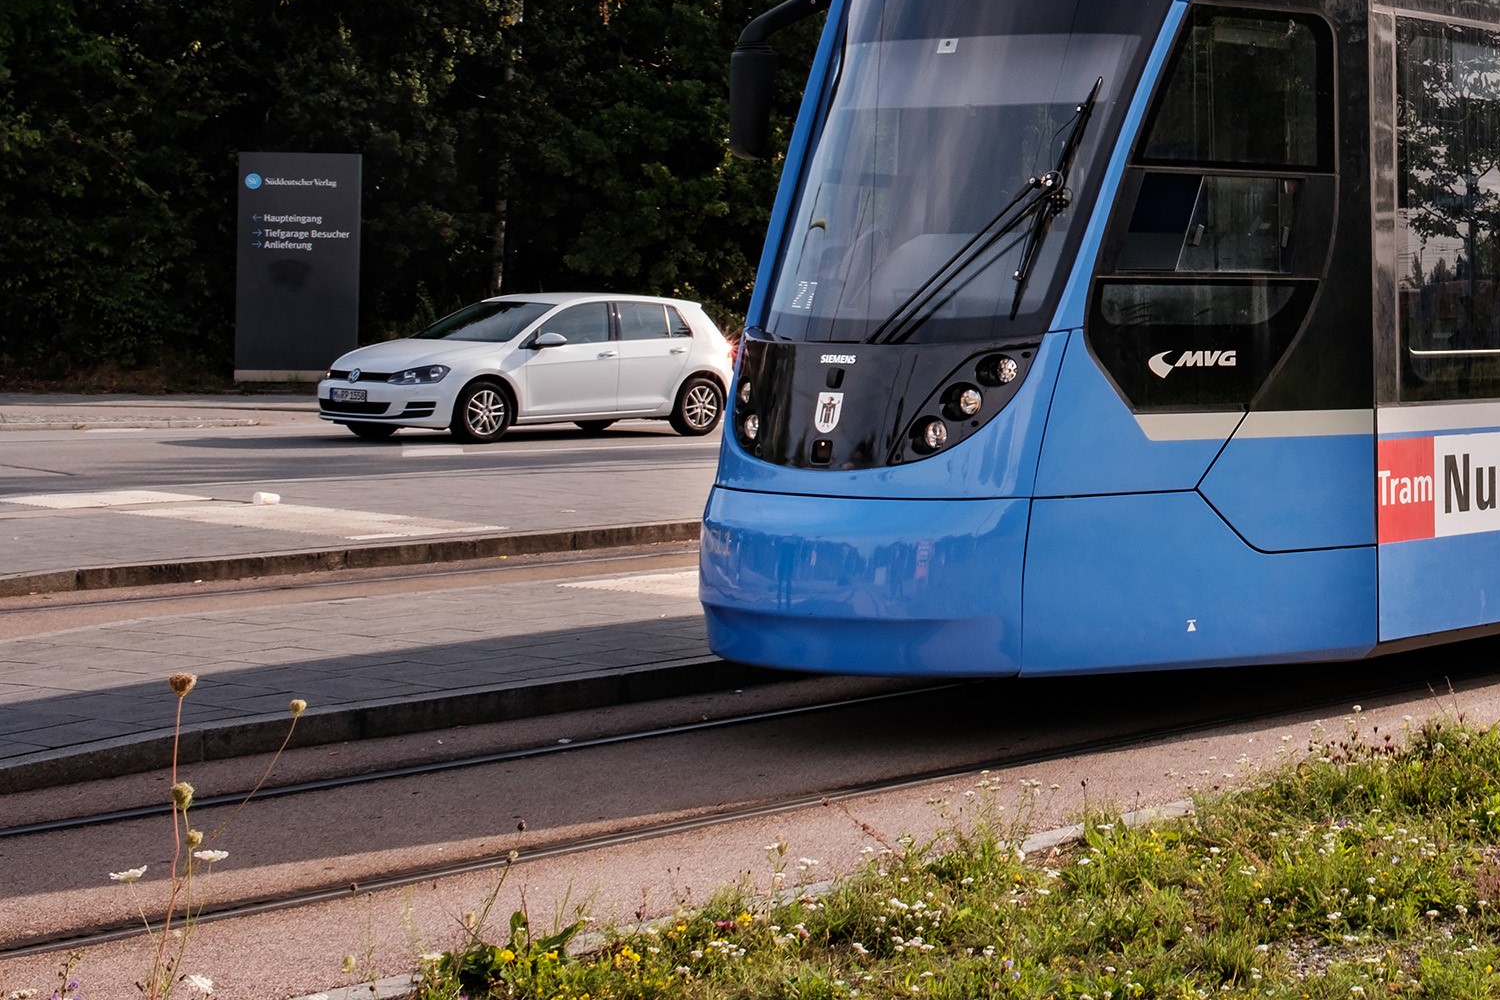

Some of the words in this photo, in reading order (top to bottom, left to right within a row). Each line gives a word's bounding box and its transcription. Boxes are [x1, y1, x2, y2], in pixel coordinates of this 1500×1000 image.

[265, 177, 313, 186] Süddeutscher
[313, 178, 338, 188] Verlag
[264, 213, 323, 225] Haupteingang
[264, 228, 310, 239] Tiefgarage
[311, 229, 350, 239] Besucher
[264, 240, 313, 251] Anlieferung
[820, 354, 857, 364] SIEMENS
[1174, 350, 1236, 367] MVG
[1378, 470, 1433, 506] Tram
